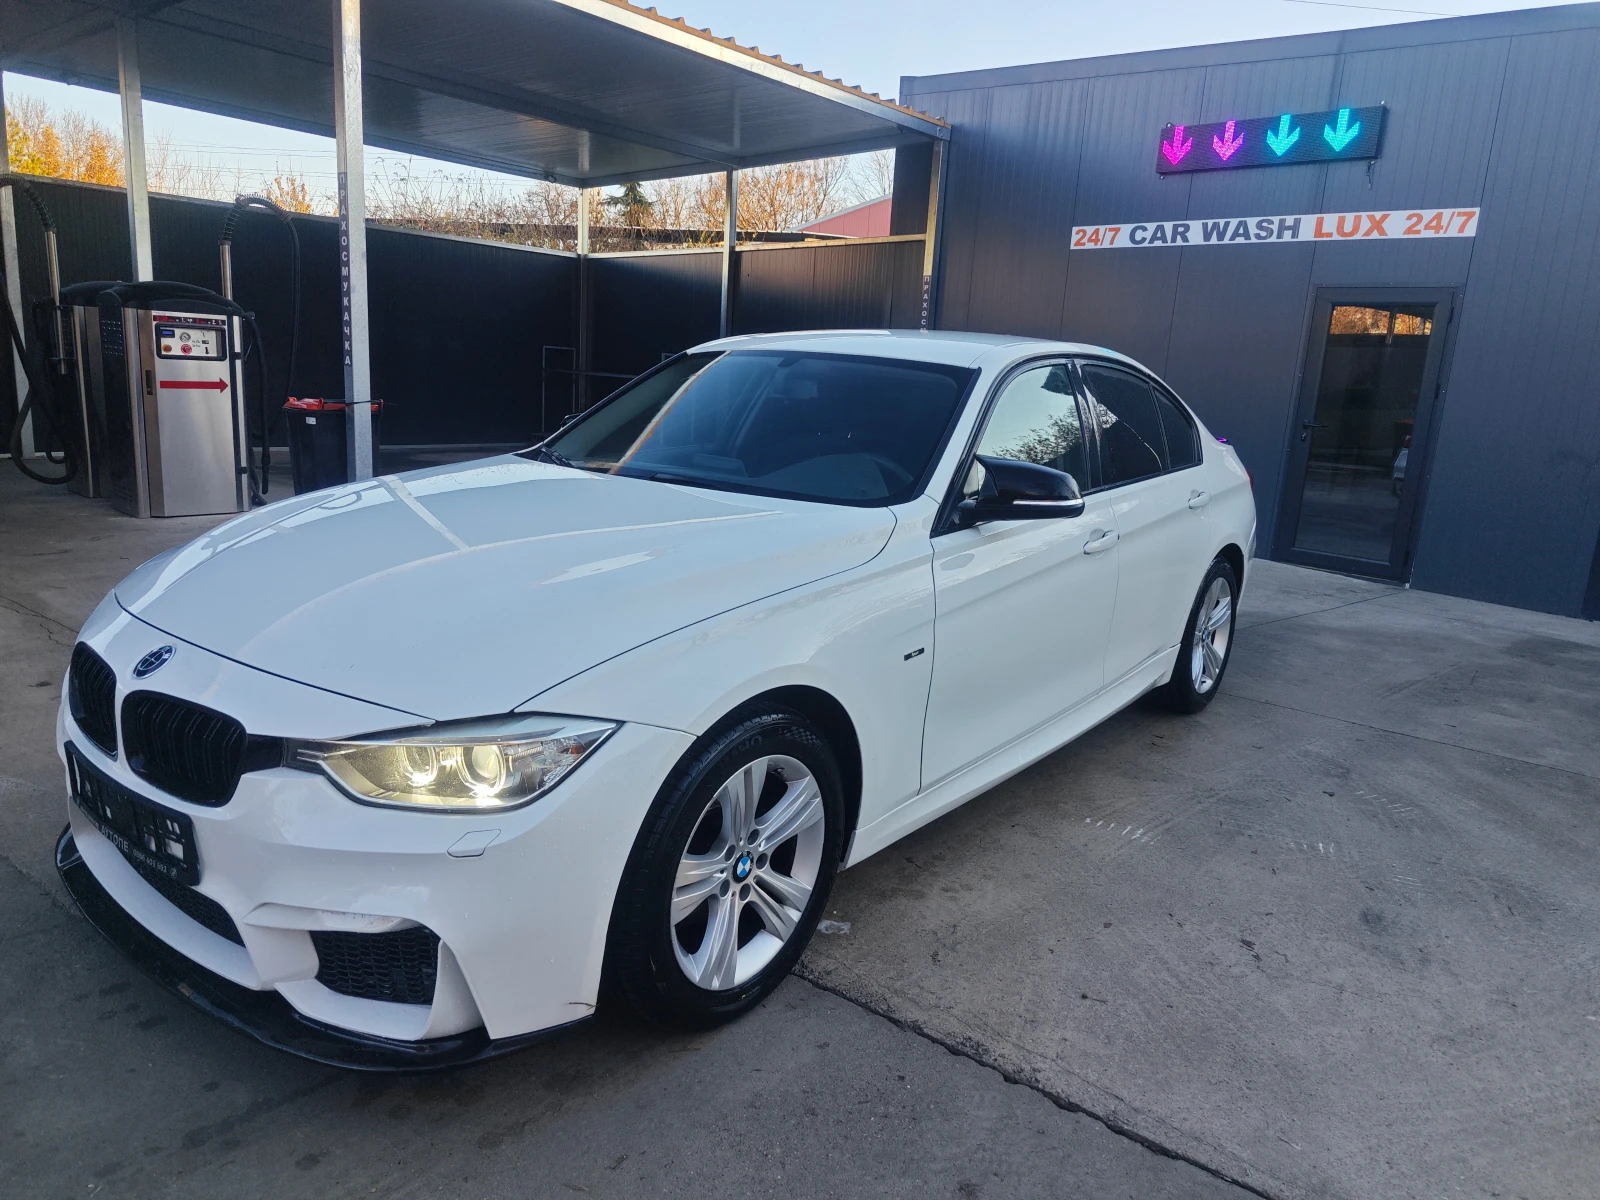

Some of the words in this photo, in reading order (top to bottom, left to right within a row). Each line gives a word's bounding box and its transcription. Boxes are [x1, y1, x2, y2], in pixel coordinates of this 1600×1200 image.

[339, 174, 351, 366] ПРАХОСМУКАЧКА
[1073, 227, 1121, 247] 24/7
[1129, 223, 1191, 245] CAR
[1201, 217, 1301, 243] WASH
[1313, 213, 1391, 239] LUX
[1402, 211, 1477, 235] 24/7
